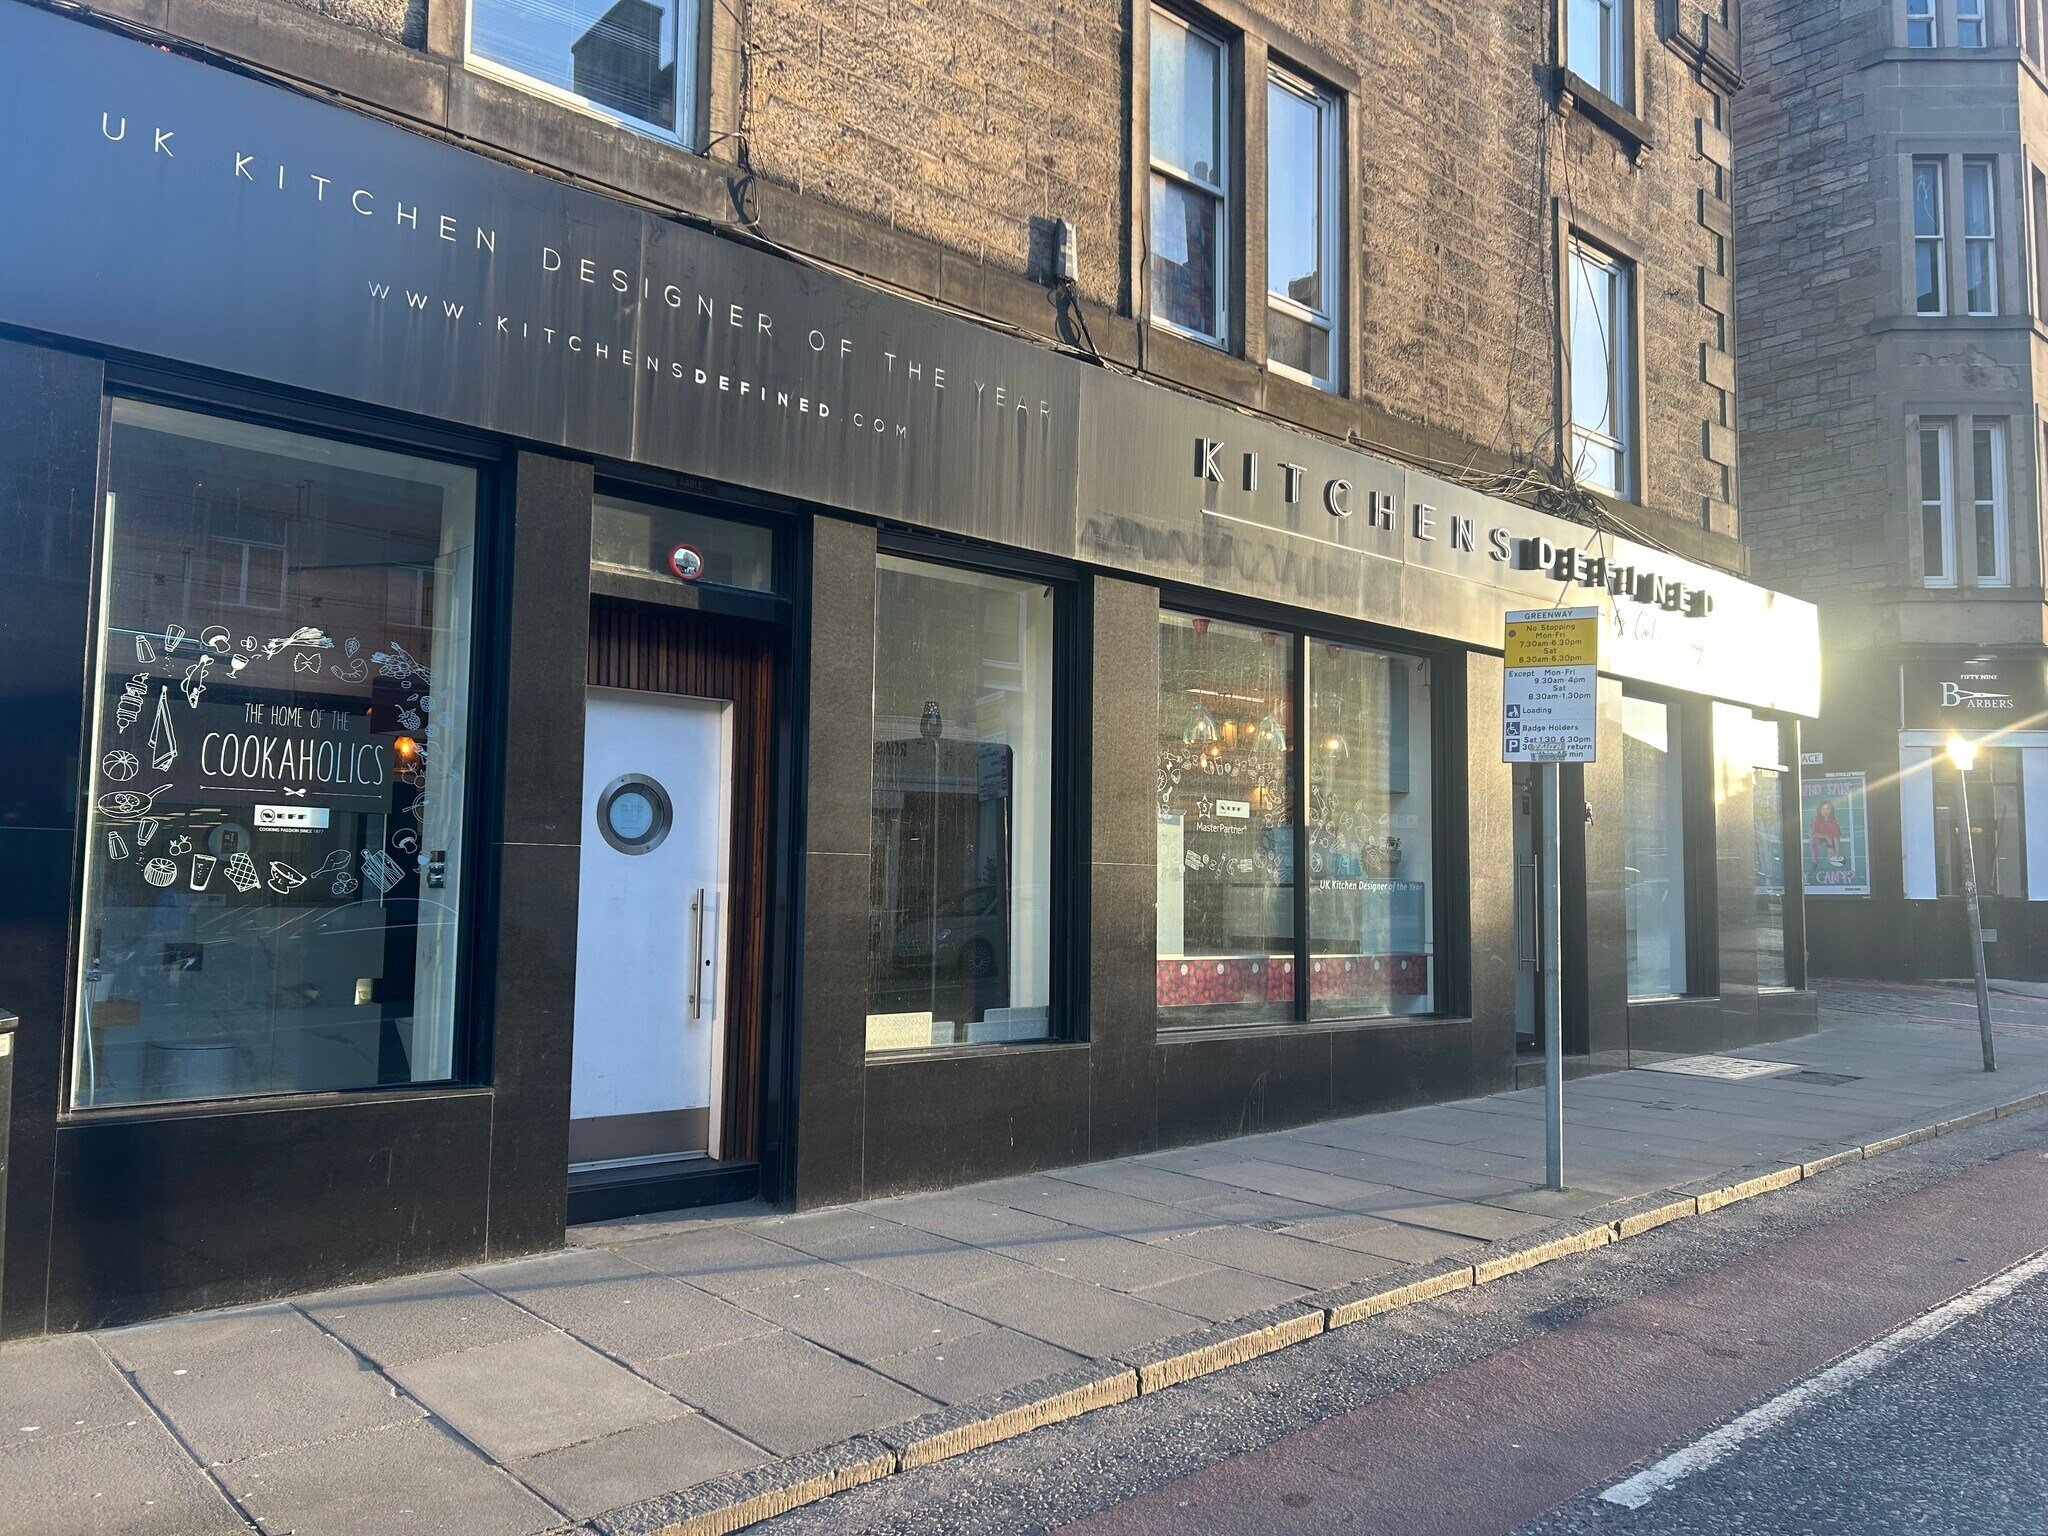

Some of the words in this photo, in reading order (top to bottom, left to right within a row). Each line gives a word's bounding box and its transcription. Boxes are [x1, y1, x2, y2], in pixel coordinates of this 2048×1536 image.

[102, 112, 174, 158] UK
[235, 151, 496, 254] KITCHEN
[542, 246, 773, 338] DESIGNER
[808, 329, 853, 358] OF
[883, 350, 946, 390] THE
[974, 380, 1051, 421] YEAR
[1524, 610, 1573, 619] GREENWAY
[1541, 623, 1575, 631] Stopping
[1519, 639, 1582, 648] 7.30am-6.30pm
[1518, 655, 1582, 664] 8.30am-6.30pm
[1508, 670, 1535, 678] Except
[1534, 676, 1586, 685] 9.30am-4pm
[1528, 692, 1591, 701] 8.30am-1.30pm
[1522, 707, 1552, 715] Loading
[244, 702, 265, 725] THE
[270, 706, 304, 728] HOME
[310, 708, 325, 729] OF
[331, 710, 350, 731] THE
[201, 732, 384, 786] COOKAHOLICS
[1320, 880, 1330, 889] UK
[1331, 880, 1357, 890] Kitchen
[1358, 881, 1387, 892] Designer
[1388, 882, 1396, 892] of
[1397, 882, 1407, 891] the
[1408, 883, 1423, 891] Year
